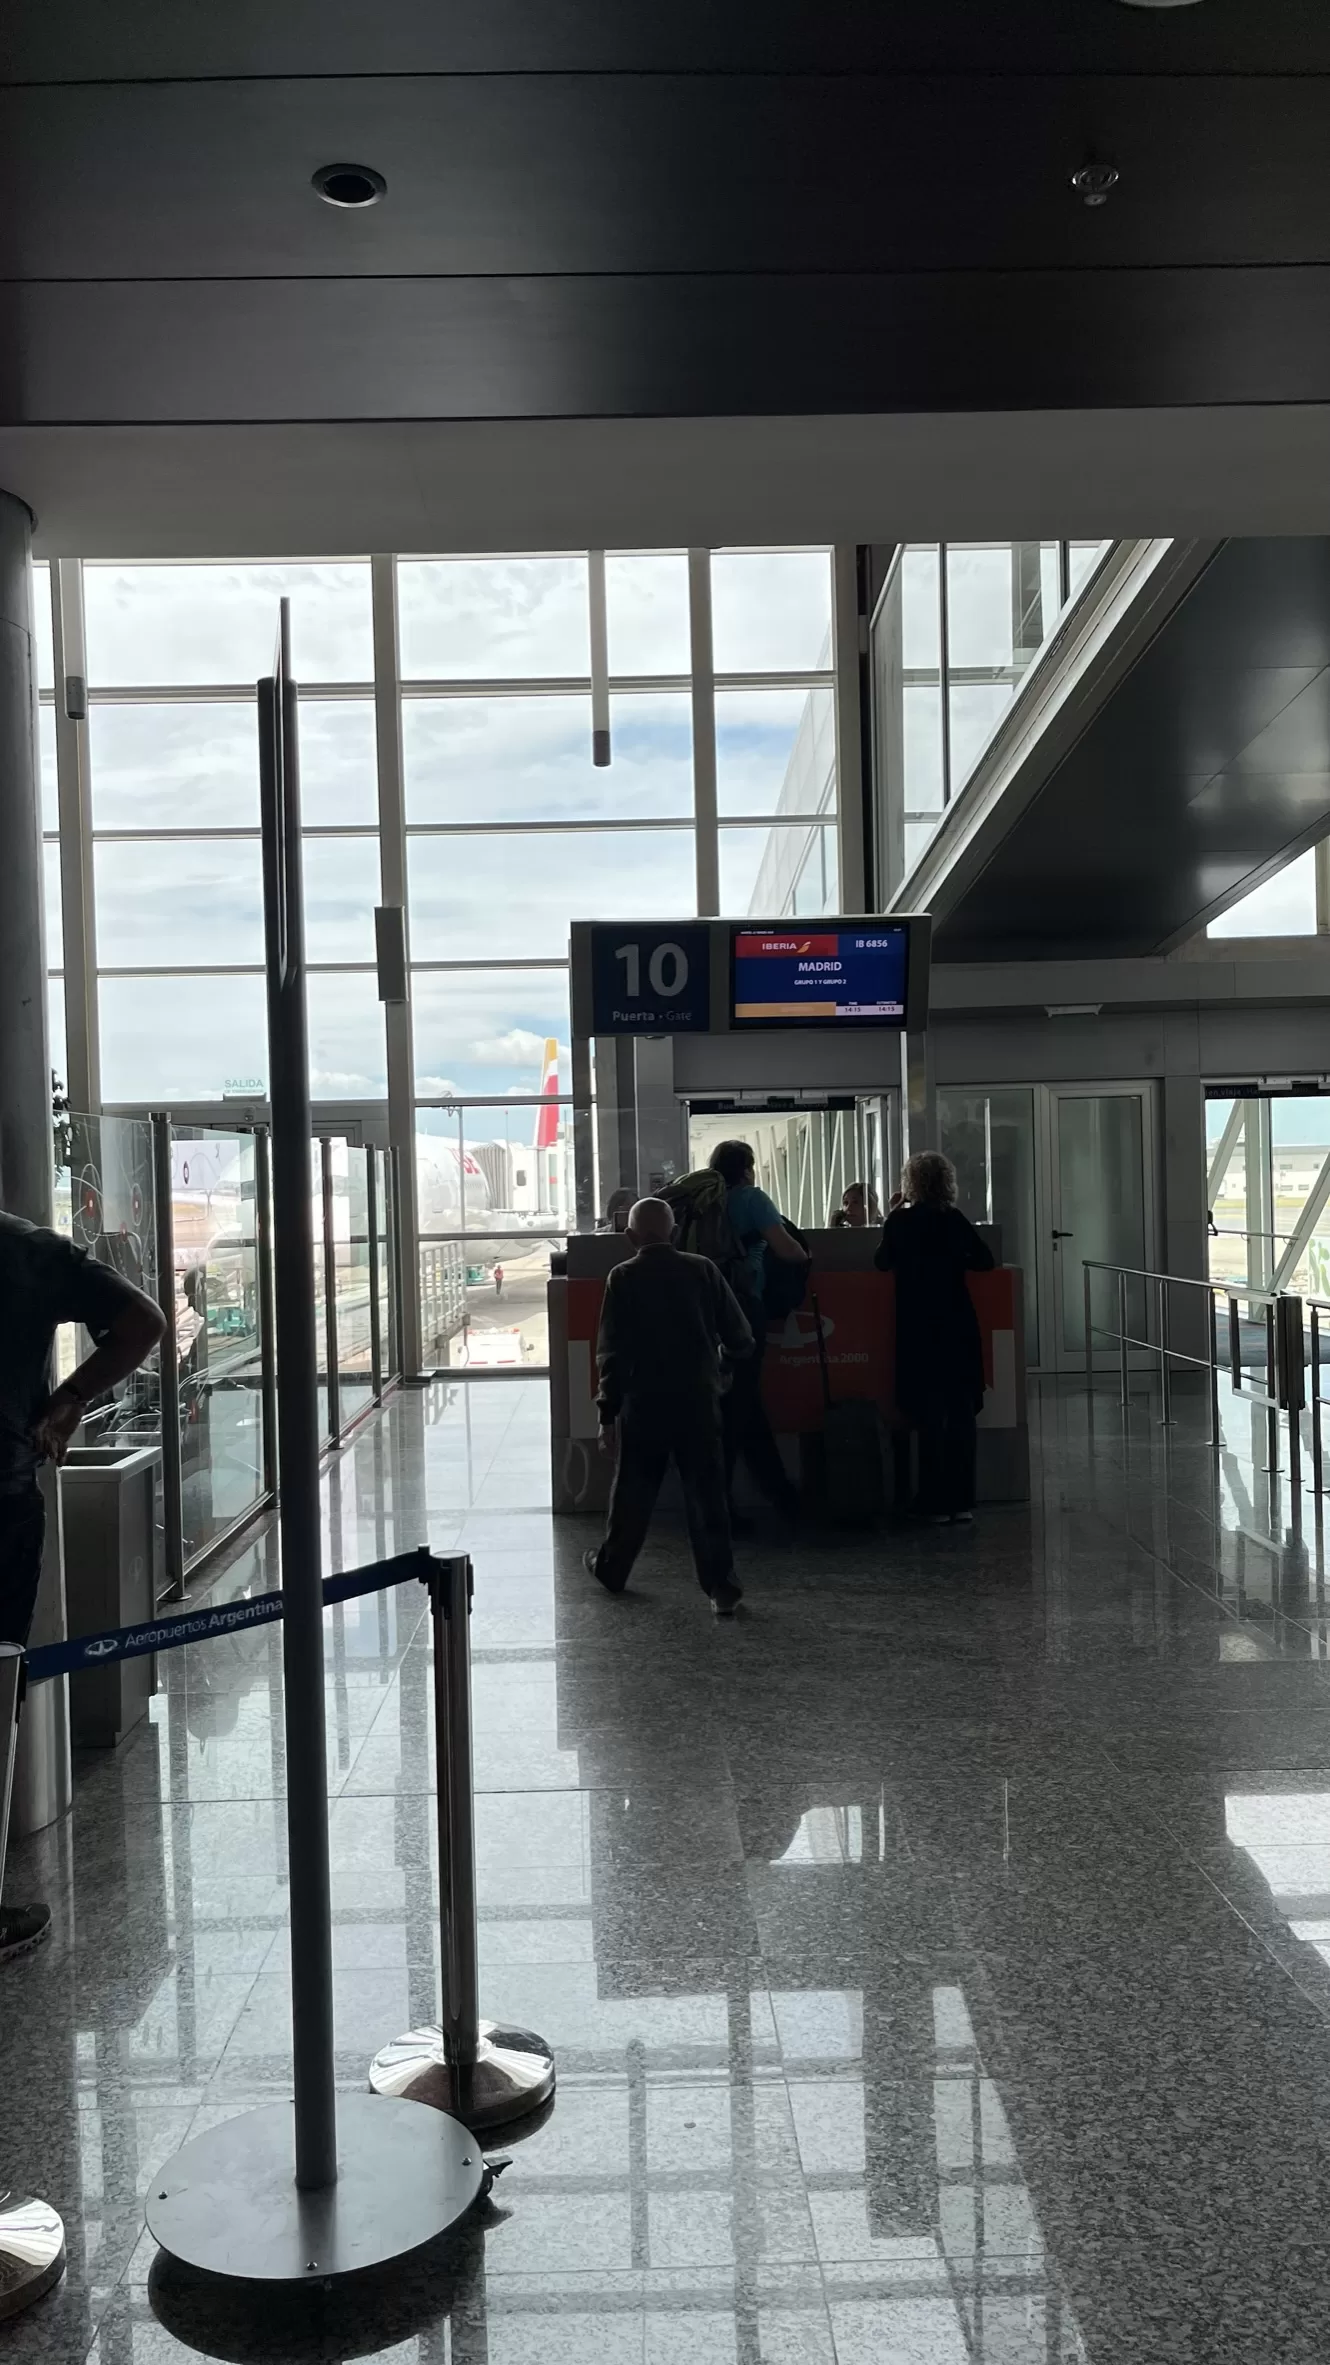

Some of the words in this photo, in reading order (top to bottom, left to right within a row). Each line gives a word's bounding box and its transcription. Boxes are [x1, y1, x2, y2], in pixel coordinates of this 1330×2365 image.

[762, 943, 797, 951] IBERIA
[855, 940, 865, 949] IB
[866, 940, 888, 948] 6856
[615, 942, 689, 997] 10
[798, 962, 842, 972] MADRID
[612, 1011, 656, 1021] Puerta
[666, 1011, 692, 1021] Gate
[224, 1080, 264, 1088] SALIDA
[840, 1352, 869, 1363] 2000
[125, 1618, 207, 1648] Aeropuertos
[208, 1599, 284, 1629] Argentina
